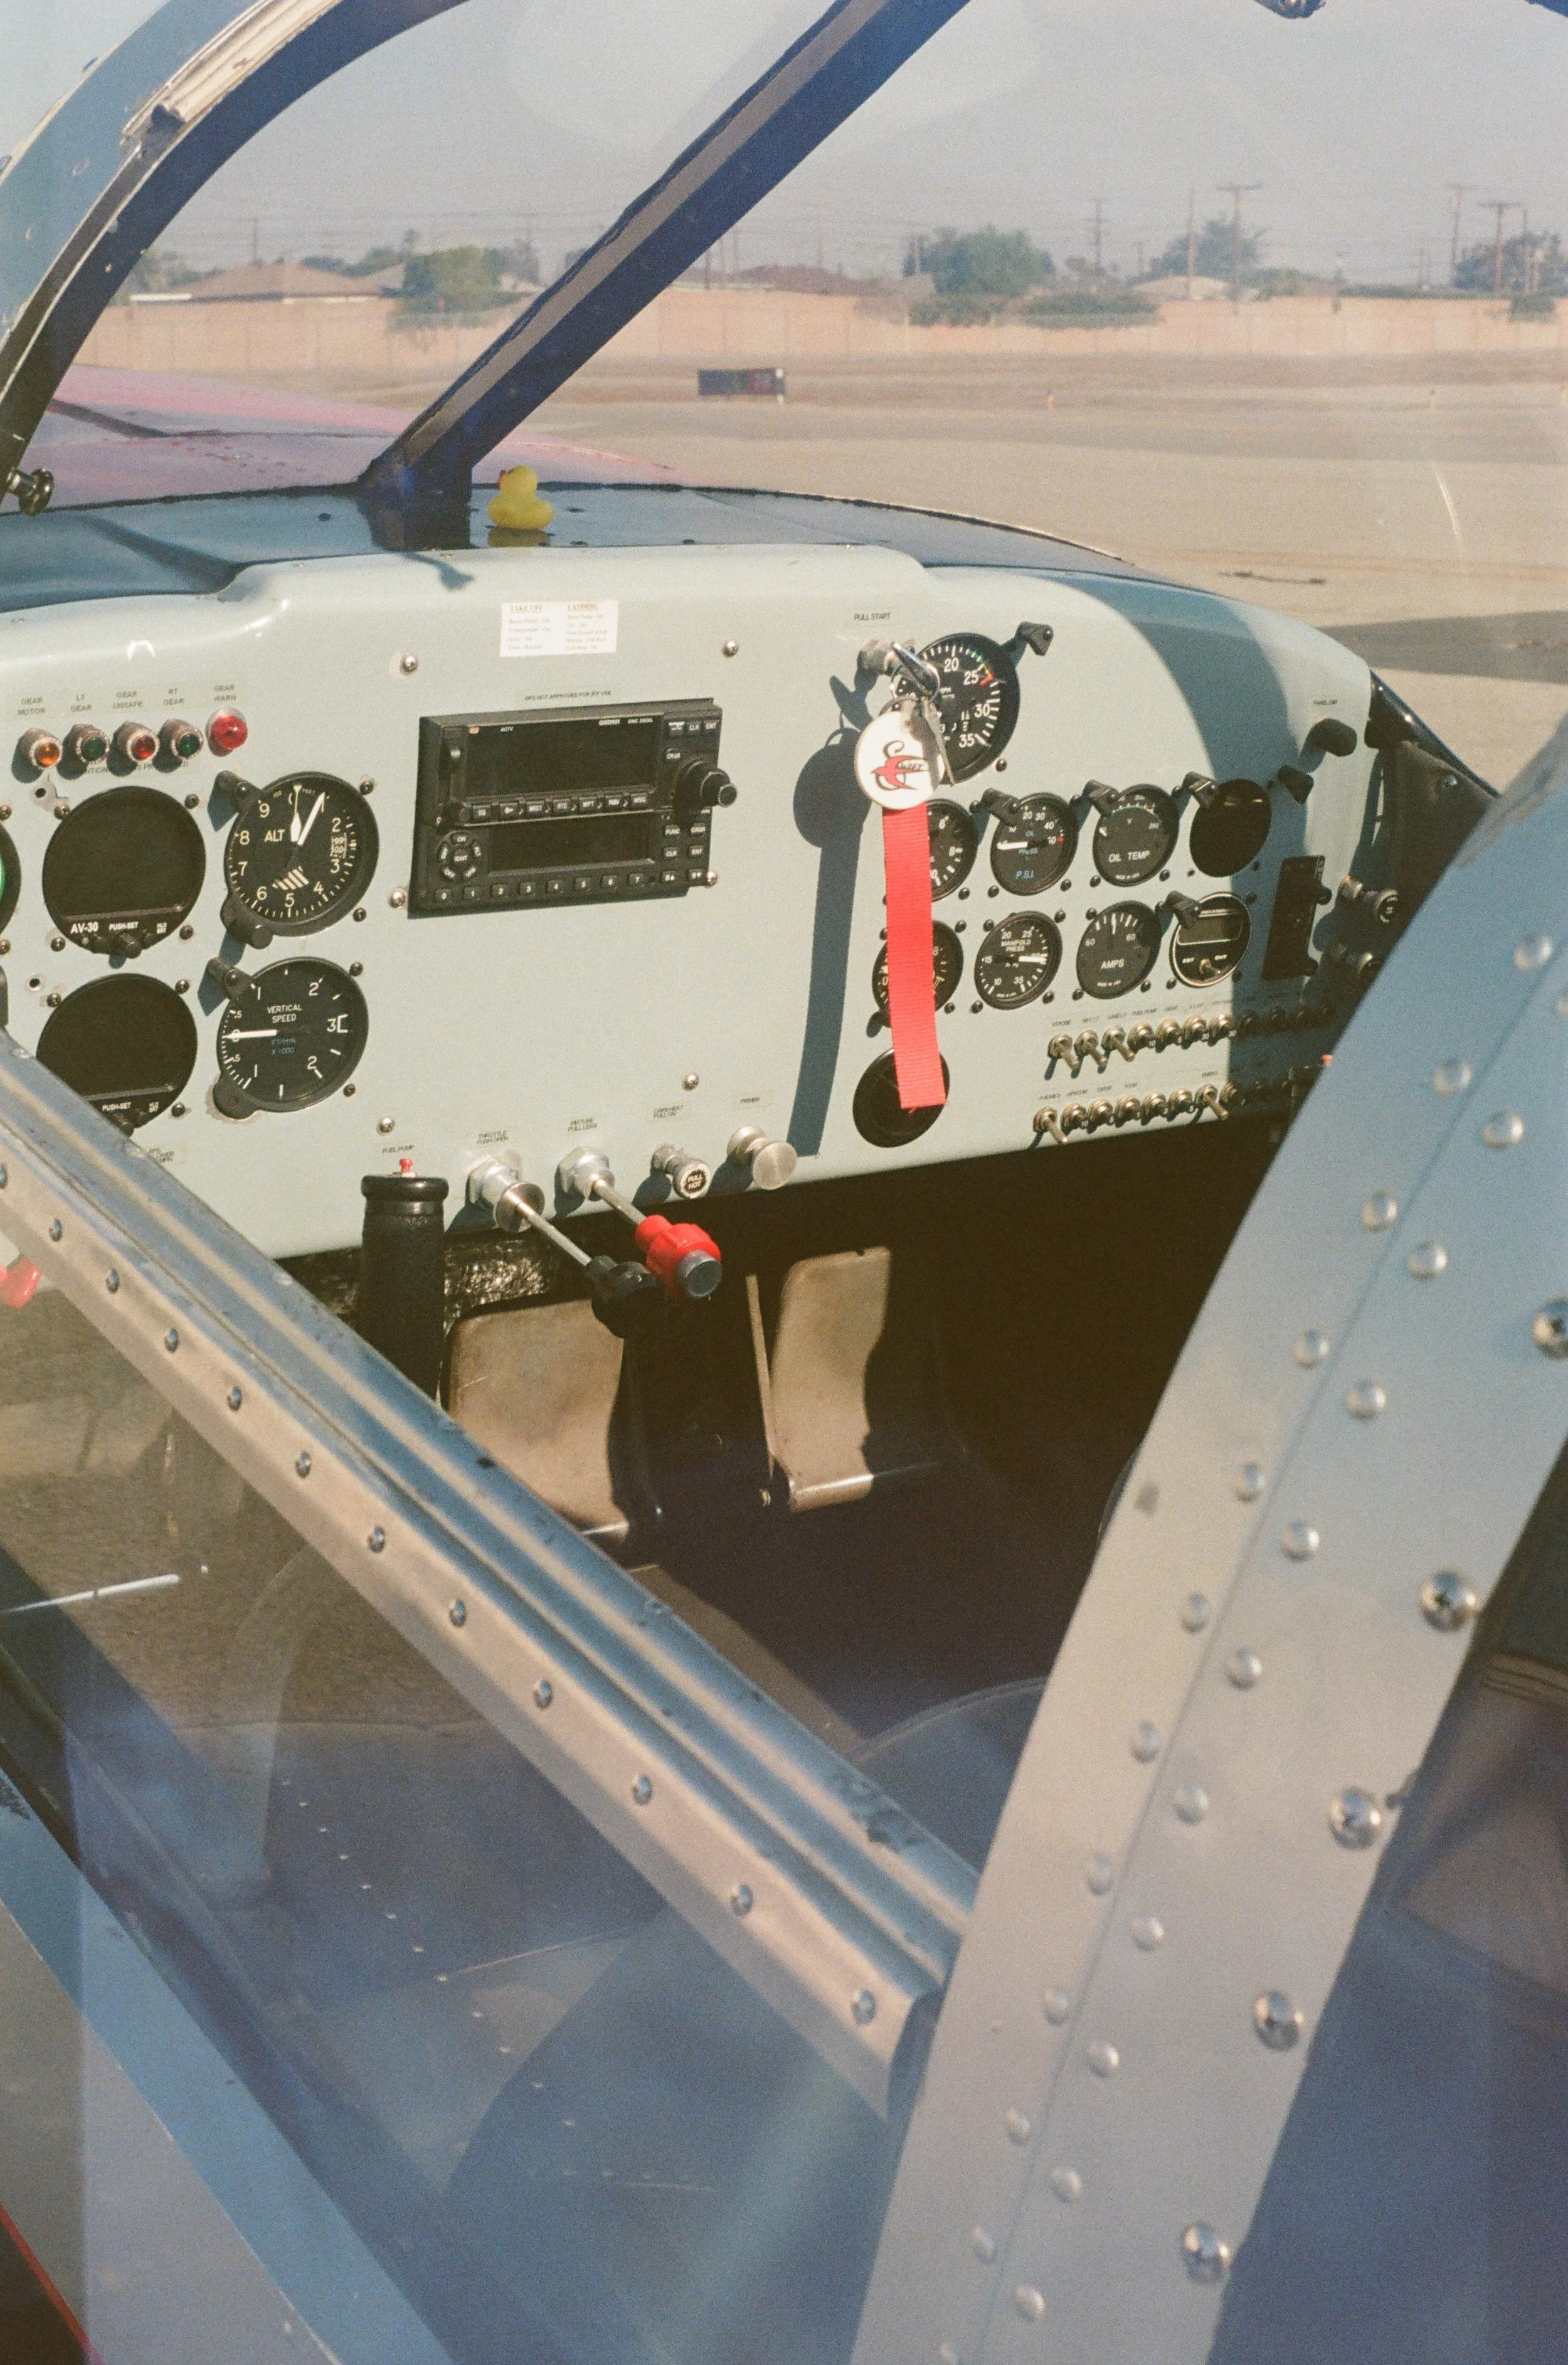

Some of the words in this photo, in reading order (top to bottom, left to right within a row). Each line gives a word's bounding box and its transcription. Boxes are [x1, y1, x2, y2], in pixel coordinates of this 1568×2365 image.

[945, 657, 959, 672] 20
[964, 669, 978, 685] 25
[21, 697, 43, 705] GEAR
[113, 701, 143, 709] UNSAFE
[18, 708, 45, 716] MOTOR
[70, 704, 92, 713] GEAR
[974, 704, 989, 718] 30
[959, 734, 974, 748] 35
[259, 803, 270, 818] 9
[1022, 811, 1033, 820] 20
[1035, 812, 1046, 821] 30
[332, 817, 342, 832] 2
[939, 819, 946, 829] 6
[1044, 821, 1054, 830] 40
[240, 830, 250, 846] 8
[263, 829, 286, 842] ALT
[949, 846, 955, 857] 8
[1109, 853, 1122, 863] OIL
[1128, 851, 1150, 861] TEMP
[238, 861, 248, 876] 7
[331, 858, 340, 874] 3
[257, 886, 267, 900] 6
[314, 881, 324, 895] 4
[285, 893, 294, 908] 5
[70, 922, 99, 934] AV-30
[109, 922, 139, 931] PUSH-SET
[1002, 931, 1012, 940] 20
[1022, 930, 1033, 938] 25
[1126, 933, 1136, 942] 60
[1086, 938, 1096, 947] 60
[1101, 959, 1125, 970] AMPS
[1014, 976, 1024, 985] 35
[309, 982, 319, 996] 2
[267, 1004, 302, 1014] VERTICAL
[272, 1014, 297, 1024] SPEED
[327, 1019, 336, 1033] 3
[307, 1056, 317, 1070] 2
[479, 1130, 507, 1139] THROTTLE
[687, 1174, 702, 1183] PULL
[688, 1181, 702, 1189] HOT
